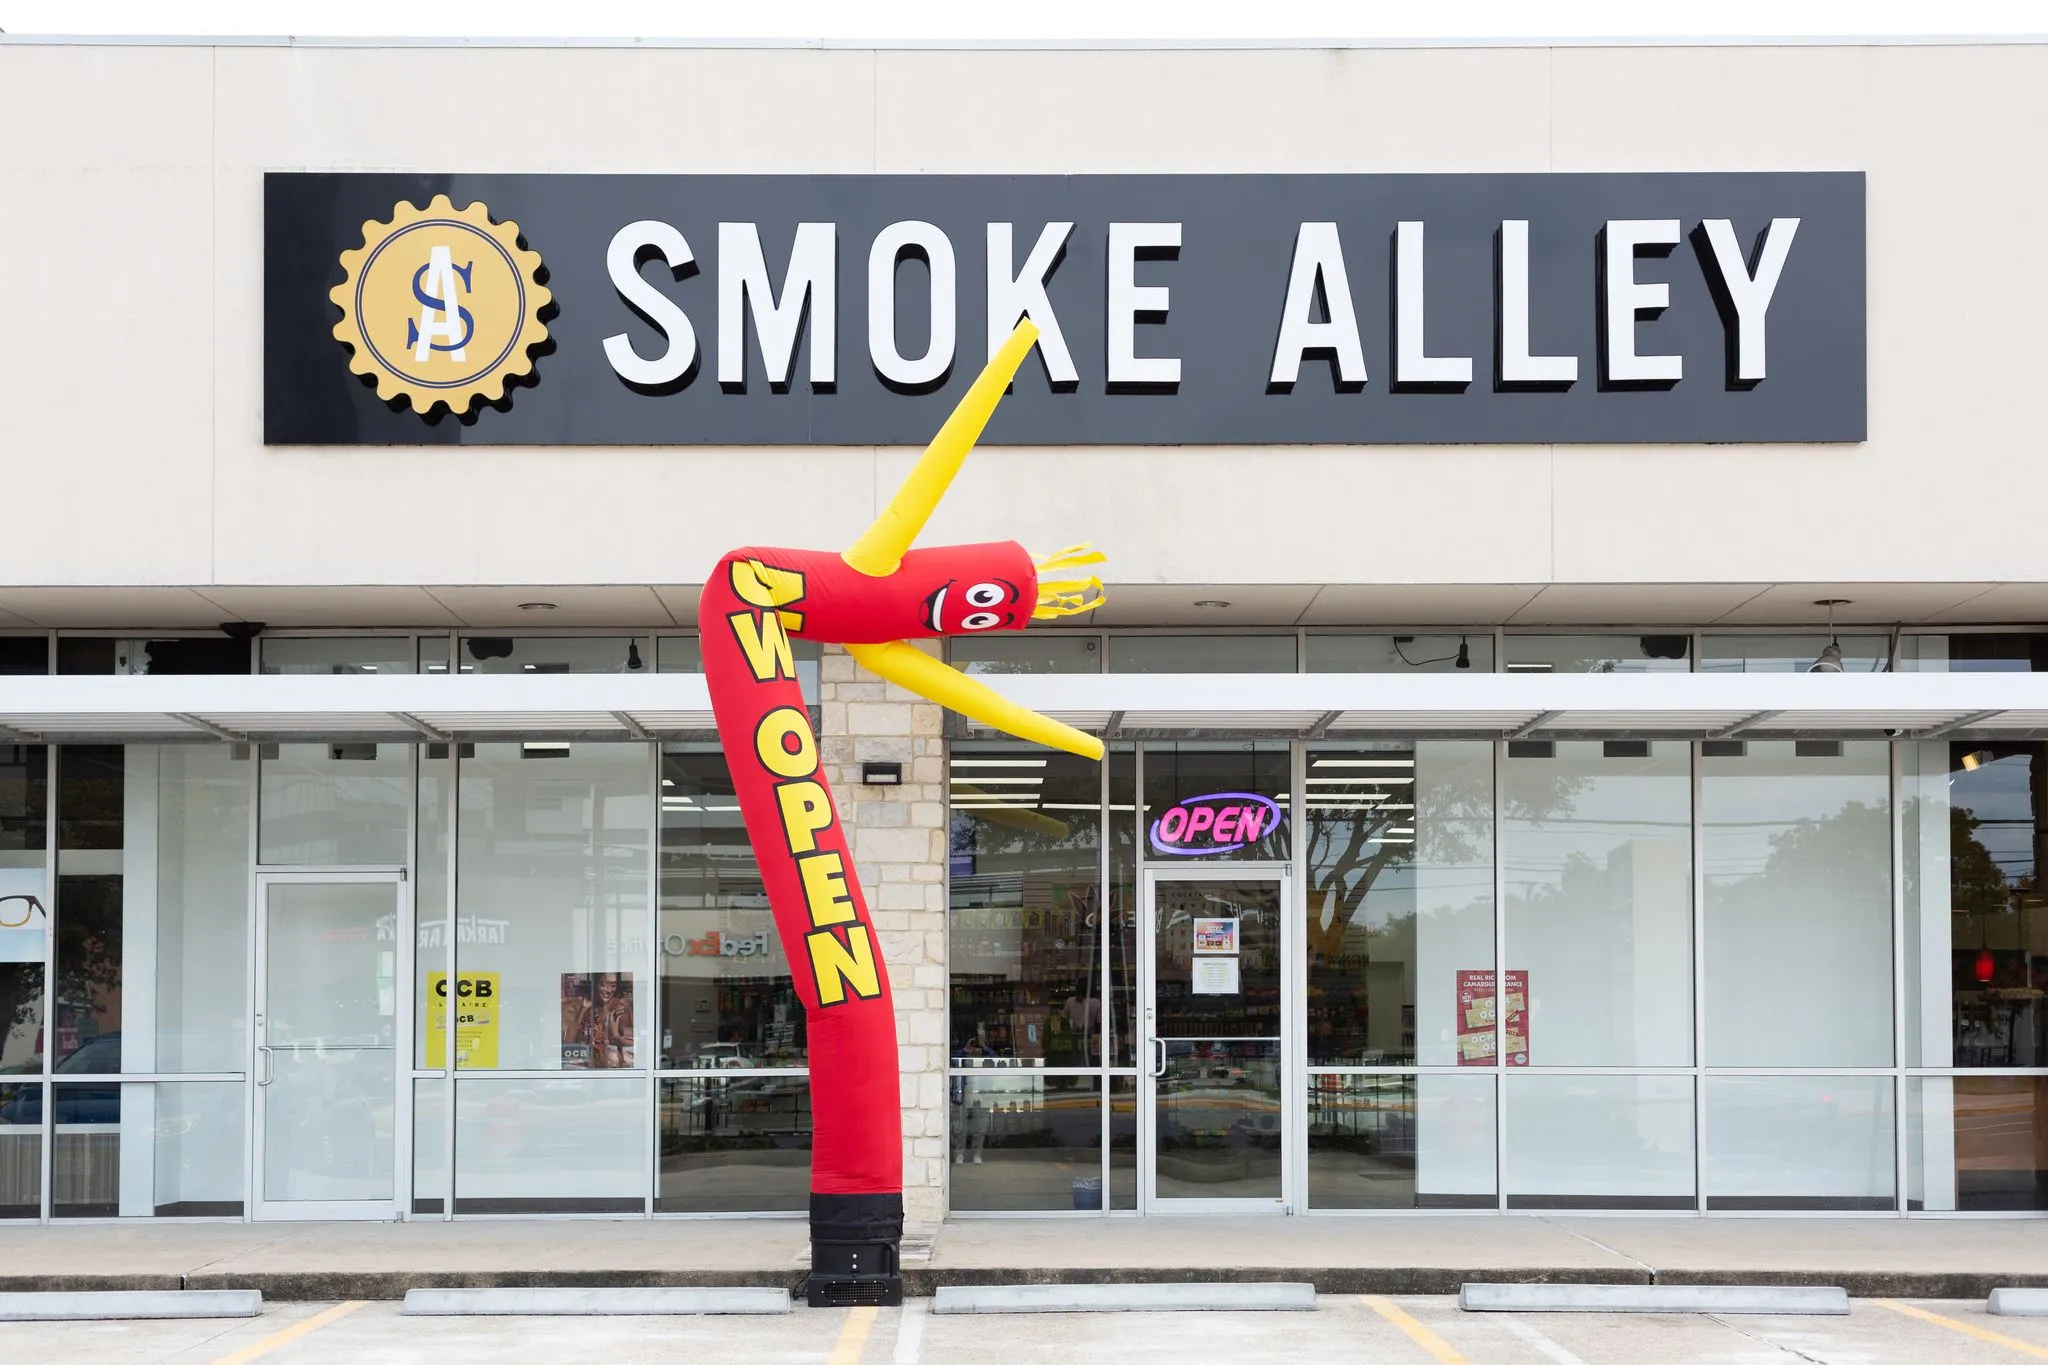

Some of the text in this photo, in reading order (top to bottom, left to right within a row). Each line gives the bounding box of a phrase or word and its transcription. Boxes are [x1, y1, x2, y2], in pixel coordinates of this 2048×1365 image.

[602, 217, 1802, 391] SMOKE ALLEY
[753, 705, 883, 1008] OPEN
[1160, 806, 1267, 842] OPEN
[564, 1048, 589, 1058] OCB
